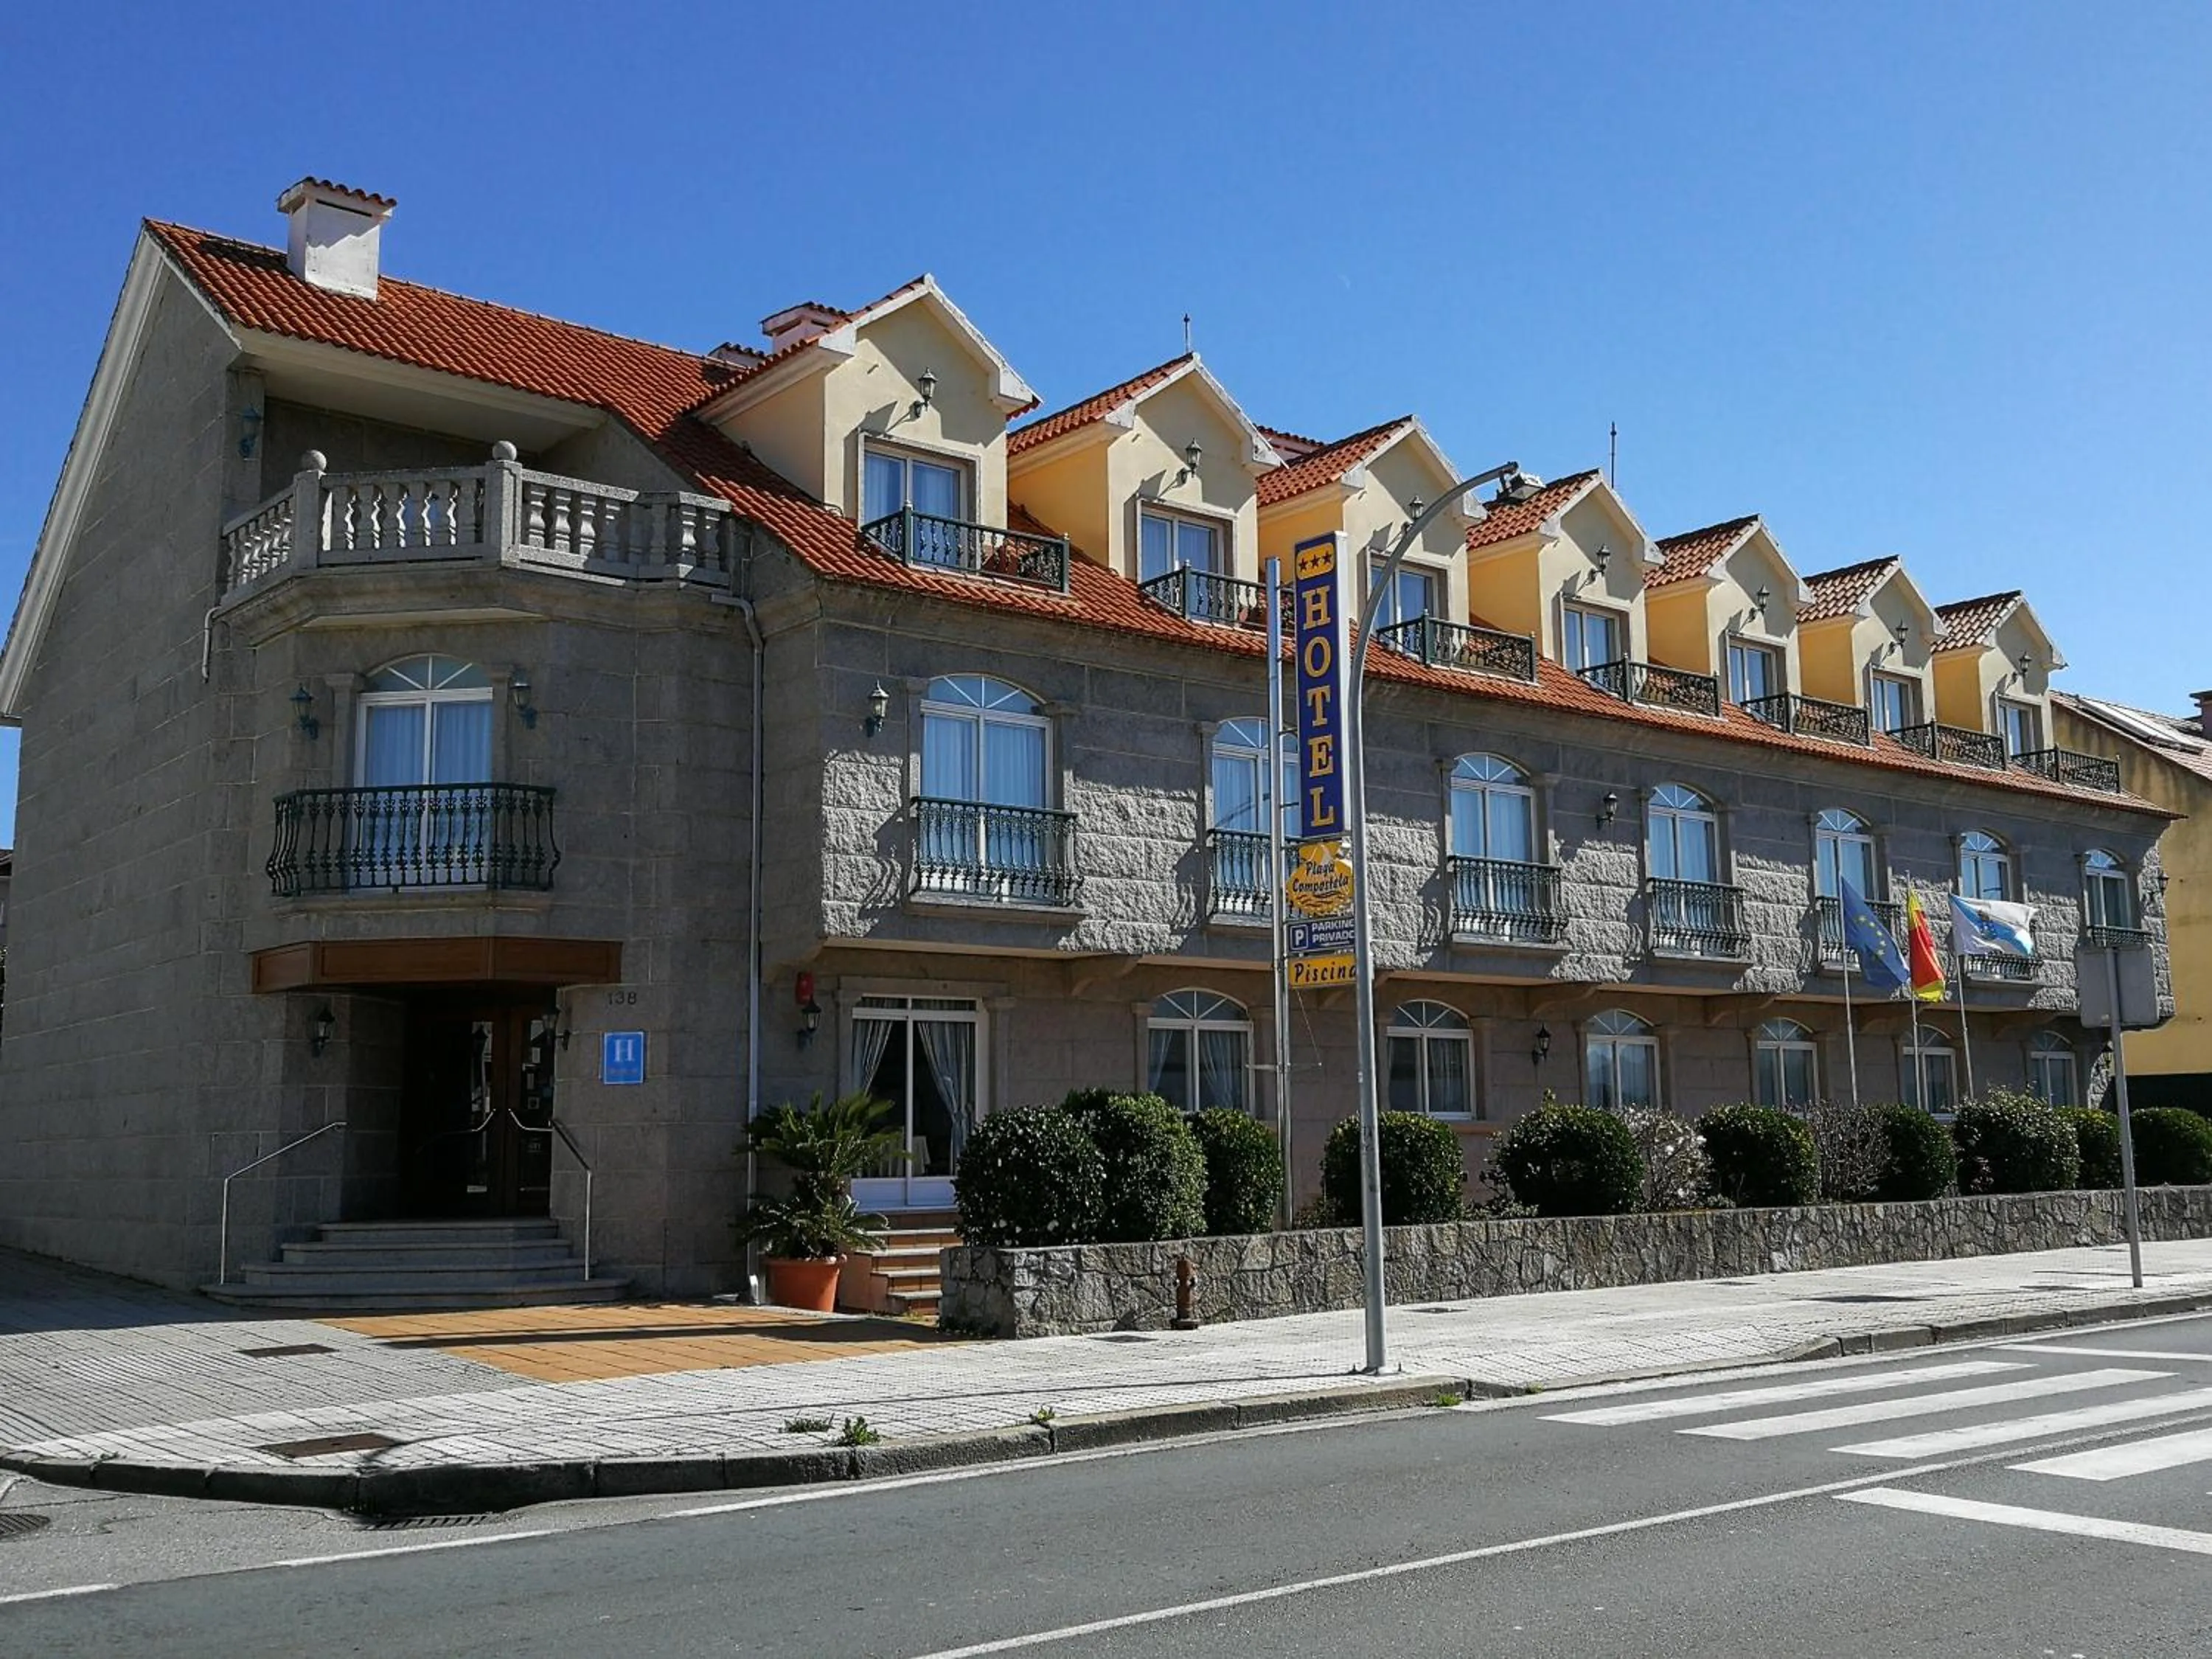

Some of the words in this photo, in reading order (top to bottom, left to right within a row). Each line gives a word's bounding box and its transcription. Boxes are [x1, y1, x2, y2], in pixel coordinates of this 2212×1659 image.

[1301, 585, 1335, 827] HOTEL
[1295, 929, 1304, 946] P
[608, 991, 637, 1005] 138
[613, 1038, 636, 1062] H
